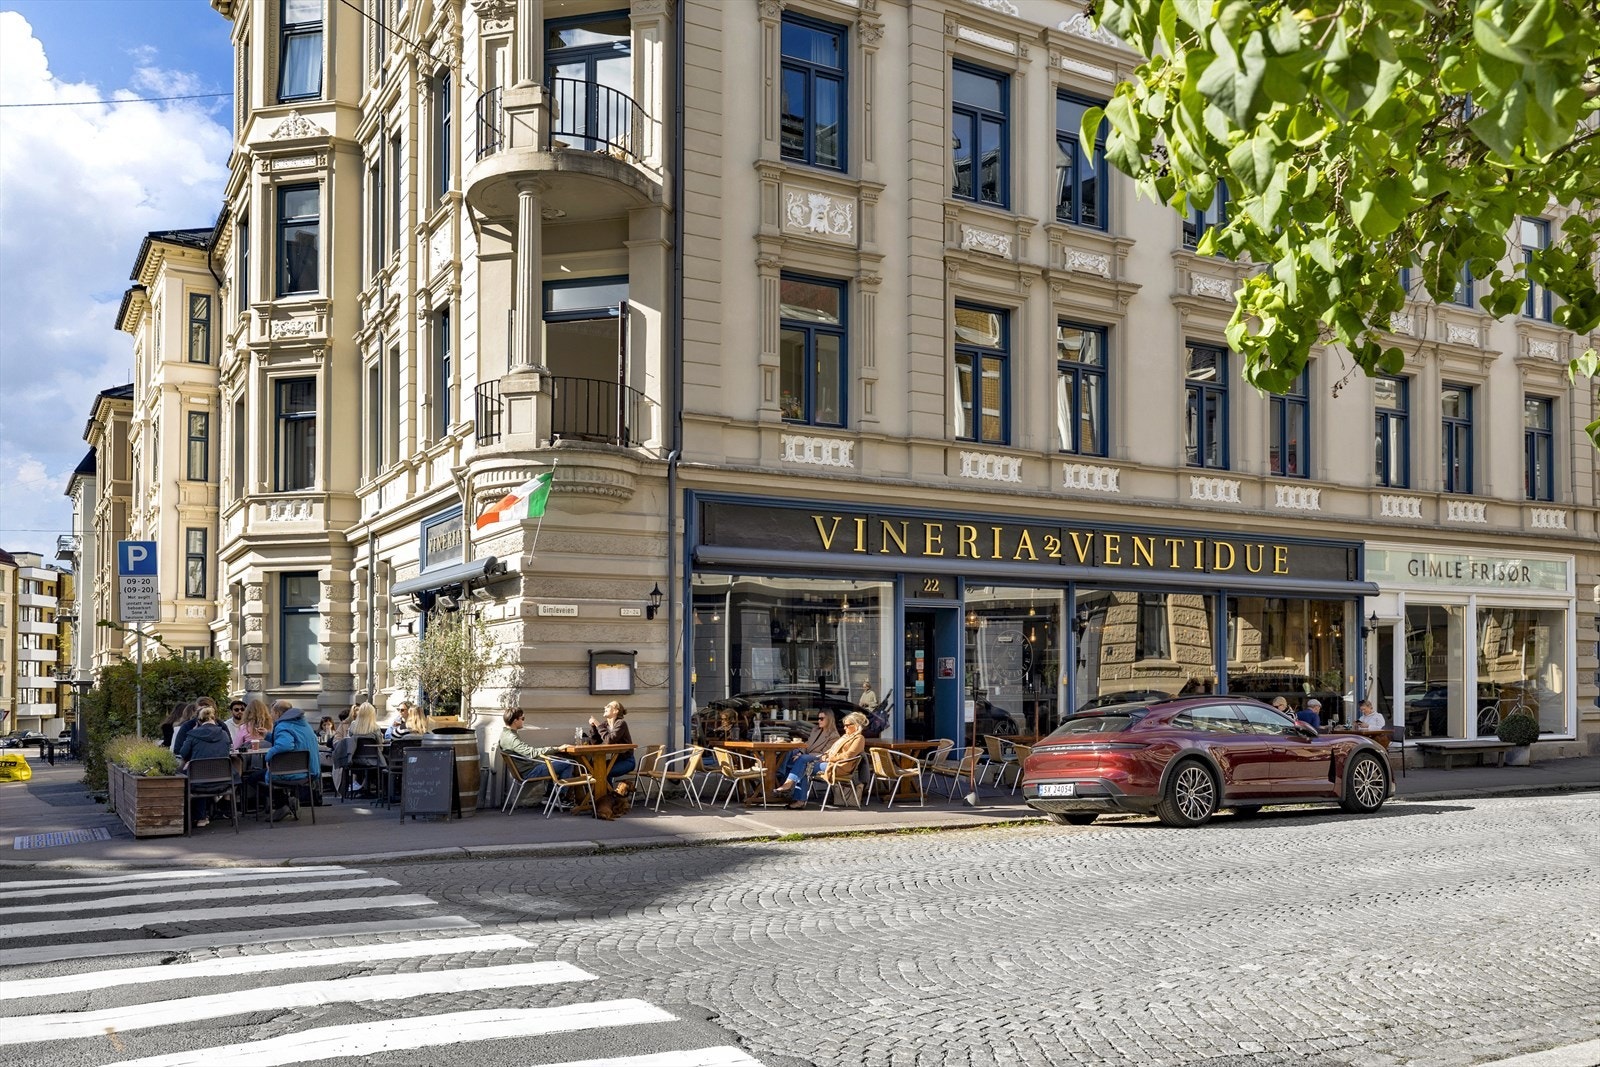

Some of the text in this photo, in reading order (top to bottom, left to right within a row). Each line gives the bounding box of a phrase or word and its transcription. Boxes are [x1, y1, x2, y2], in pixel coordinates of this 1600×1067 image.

[811, 515, 1040, 561] VINERIA
[1068, 531, 1290, 575] VENTIDUE
[127, 545, 148, 571] P
[1407, 559, 1531, 583] GIMLE FRISØR
[923, 578, 940, 592] 22
[542, 605, 575, 614] Gimleveien
[1043, 784, 1072, 794] SX 24054
